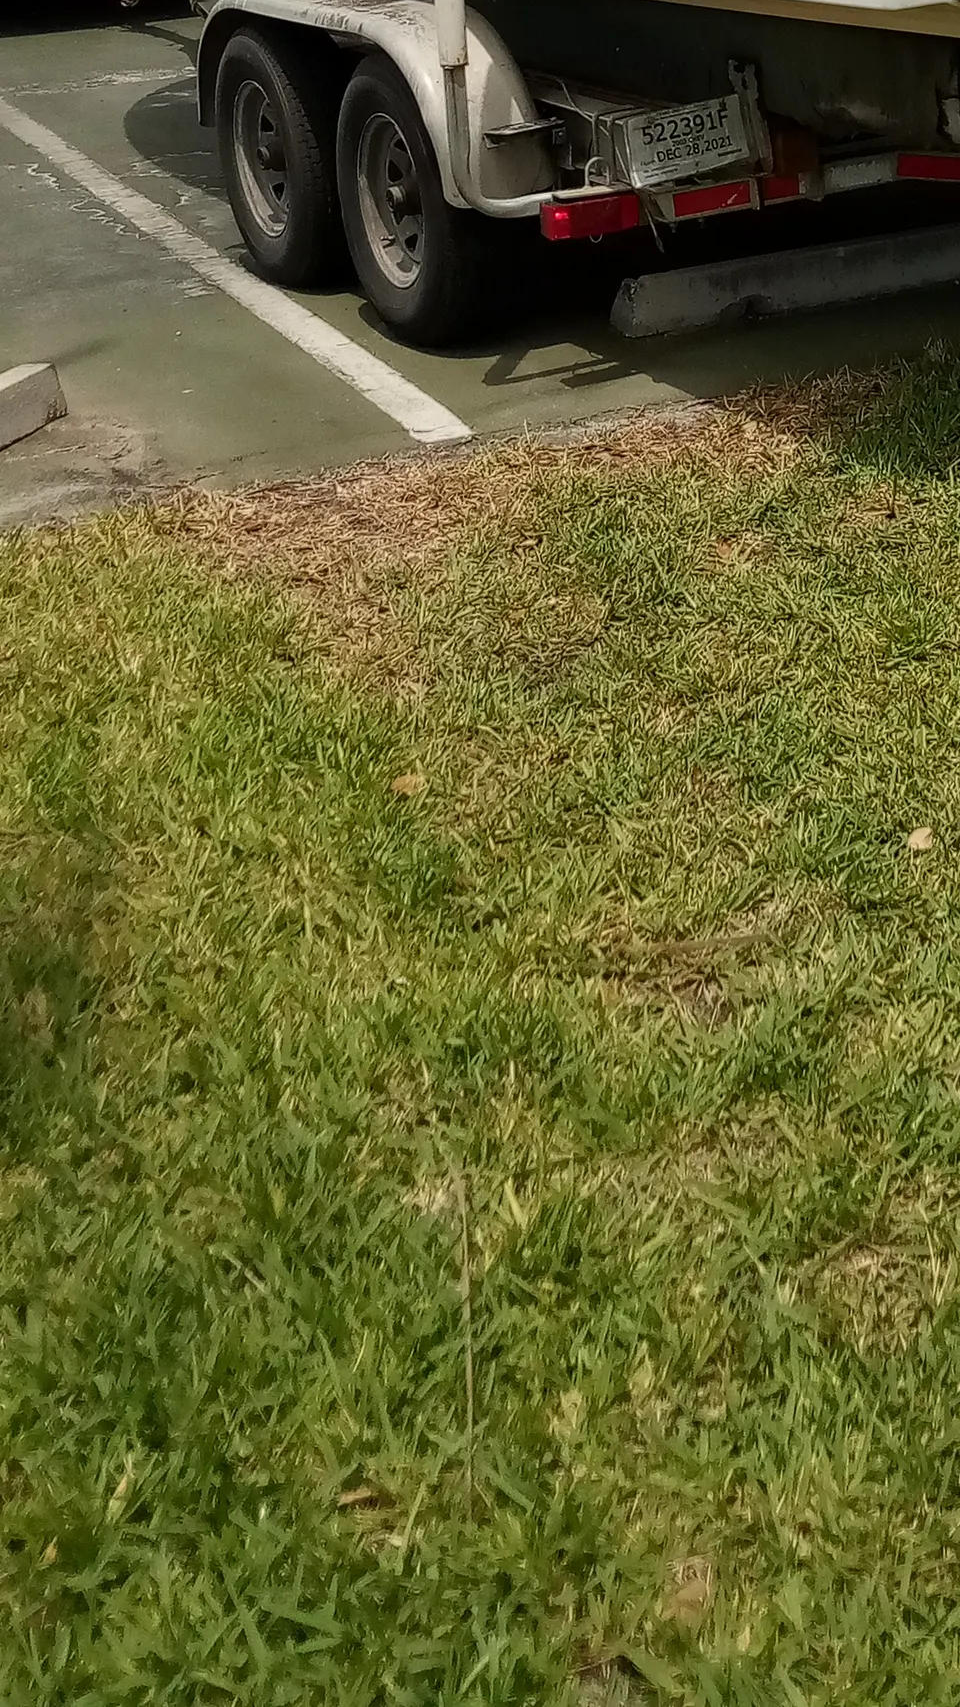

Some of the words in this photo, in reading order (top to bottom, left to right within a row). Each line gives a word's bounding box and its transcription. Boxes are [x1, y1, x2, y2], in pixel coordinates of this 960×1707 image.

[641, 108, 729, 145] 522391F
[656, 147, 682, 162] DEC
[685, 135, 733, 156] 28,2021
